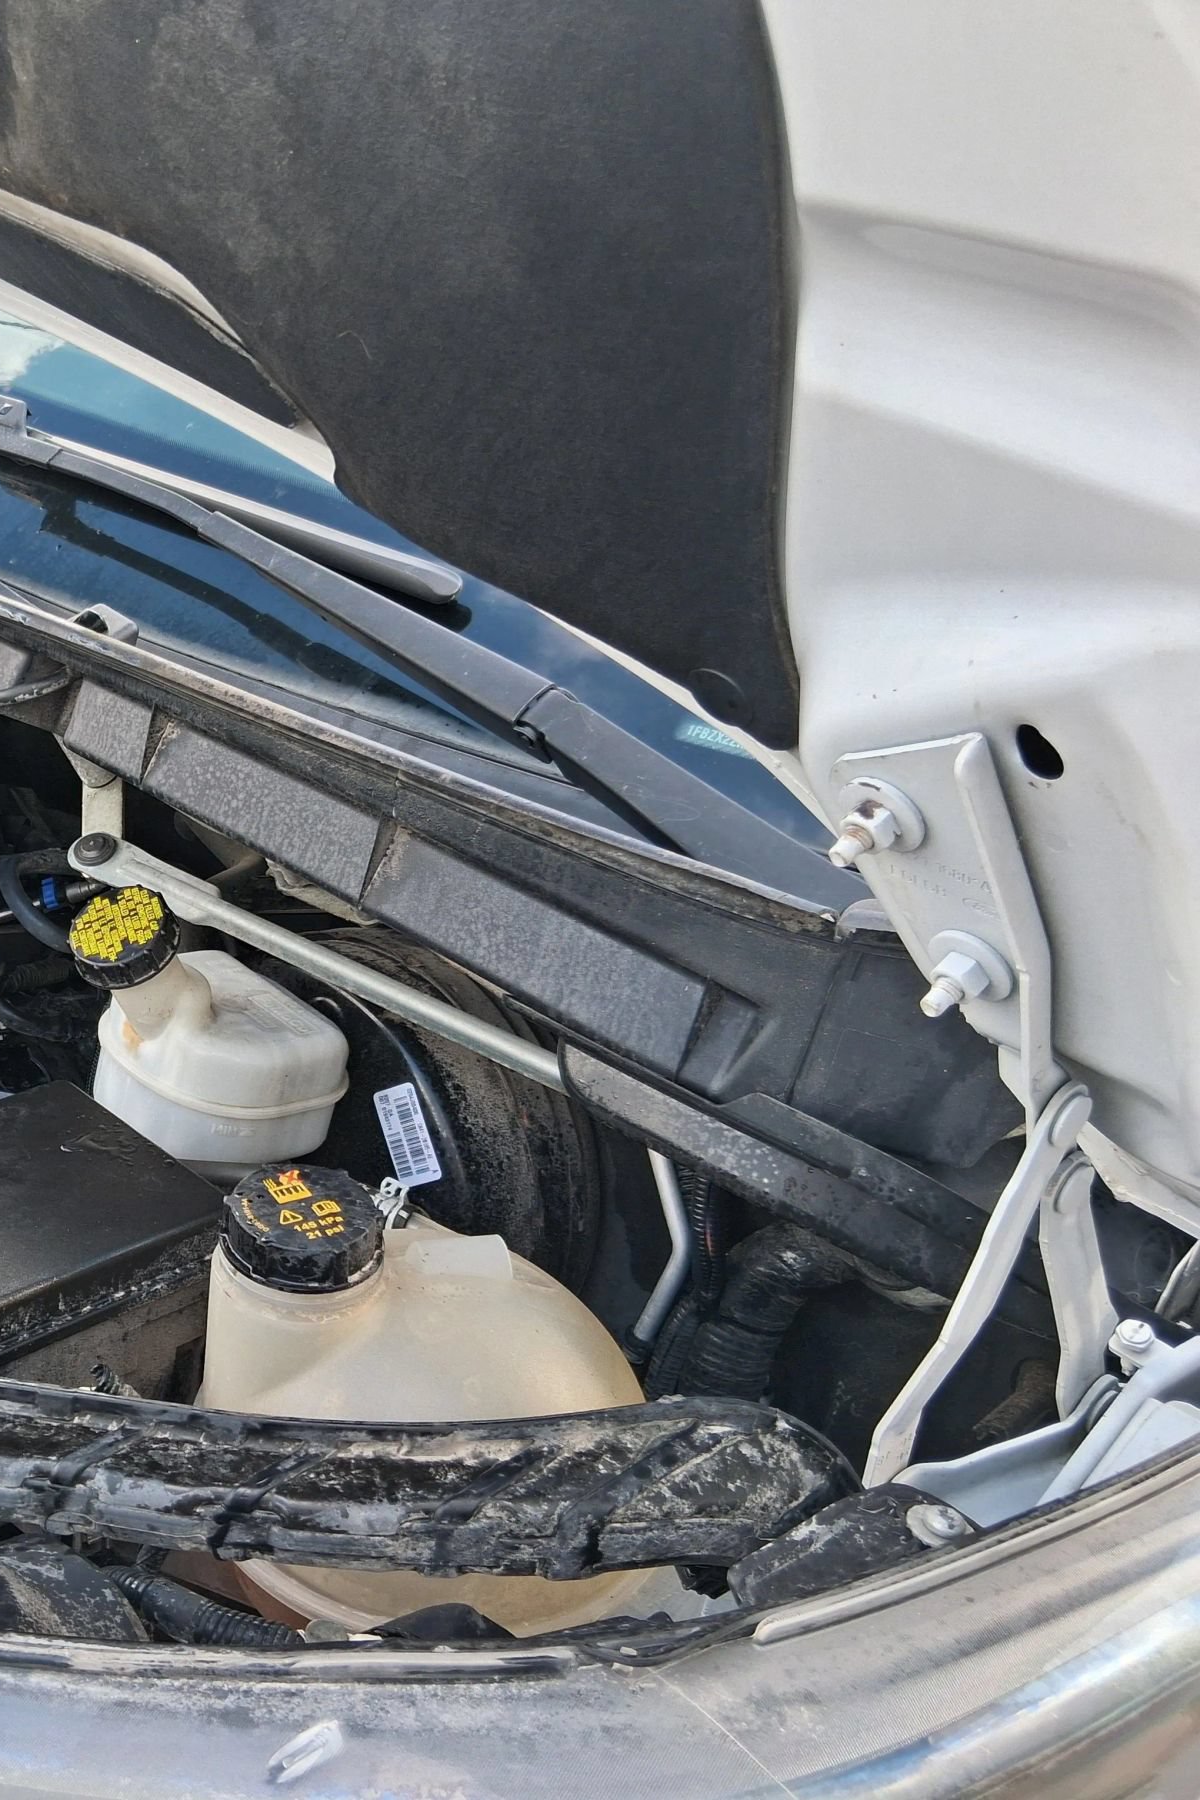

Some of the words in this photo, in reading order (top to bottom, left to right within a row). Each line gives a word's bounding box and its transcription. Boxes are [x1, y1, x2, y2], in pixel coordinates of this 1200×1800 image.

[688, 725, 744, 749] 1FBZX22
[294, 1221, 318, 1232] 145
[319, 1215, 344, 1227] kPa
[306, 1231, 322, 1240] 21
[325, 1225, 344, 1236] psi
